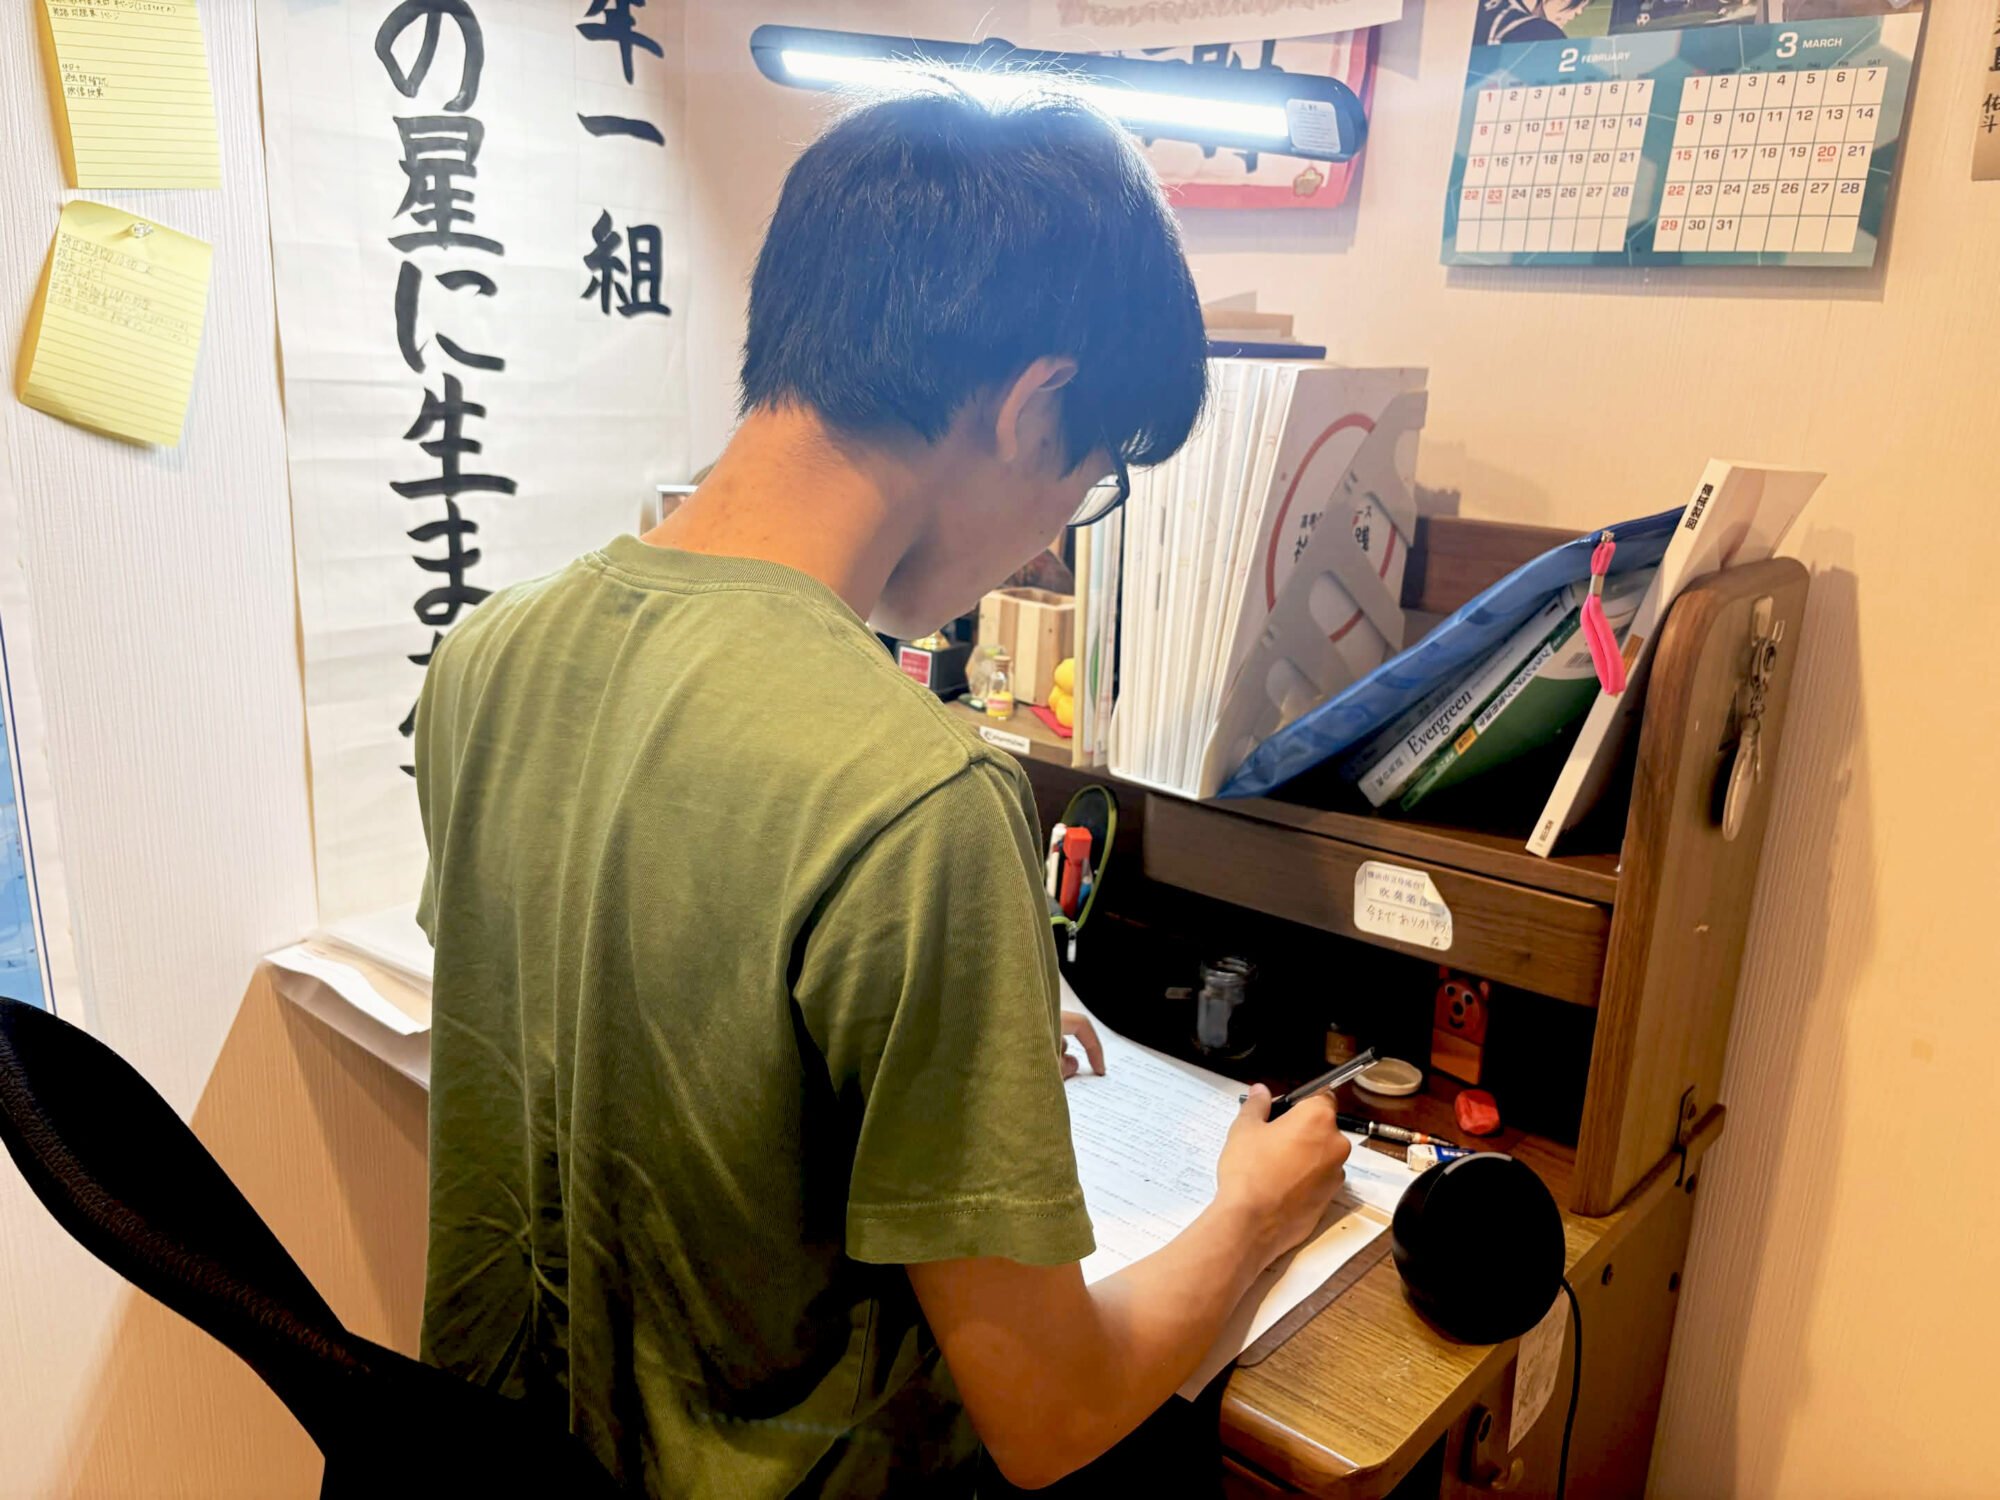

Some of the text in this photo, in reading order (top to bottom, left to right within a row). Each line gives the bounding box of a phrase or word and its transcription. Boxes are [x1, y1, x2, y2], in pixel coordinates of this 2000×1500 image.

[1776, 32, 1843, 57] 3 MARCH
[1558, 48, 1631, 73] 2 FEBRUARY
[1693, 70, 1877, 90] 1 2 3 4 5 6 7
[1486, 83, 1645, 103] 1 2 3 4 5 6 7
[1685, 107, 1874, 126] 8 9 10 11 12 13 14
[1479, 117, 1643, 136] 8 9 10 11 12 13 14
[1471, 152, 1635, 168] 15 16 17 18 19 20 21
[1675, 145, 1866, 161] 15 16 17 18 19 20 21
[1463, 186, 1629, 201] 22 23 24 25 26 27 28
[1667, 182, 1860, 196] 22 23 24 25 26 27 28
[1660, 219, 1733, 231] 29 30 31
[374, 0, 517, 738] の星に生ま
[1406, 689, 1473, 757] Evergreen
